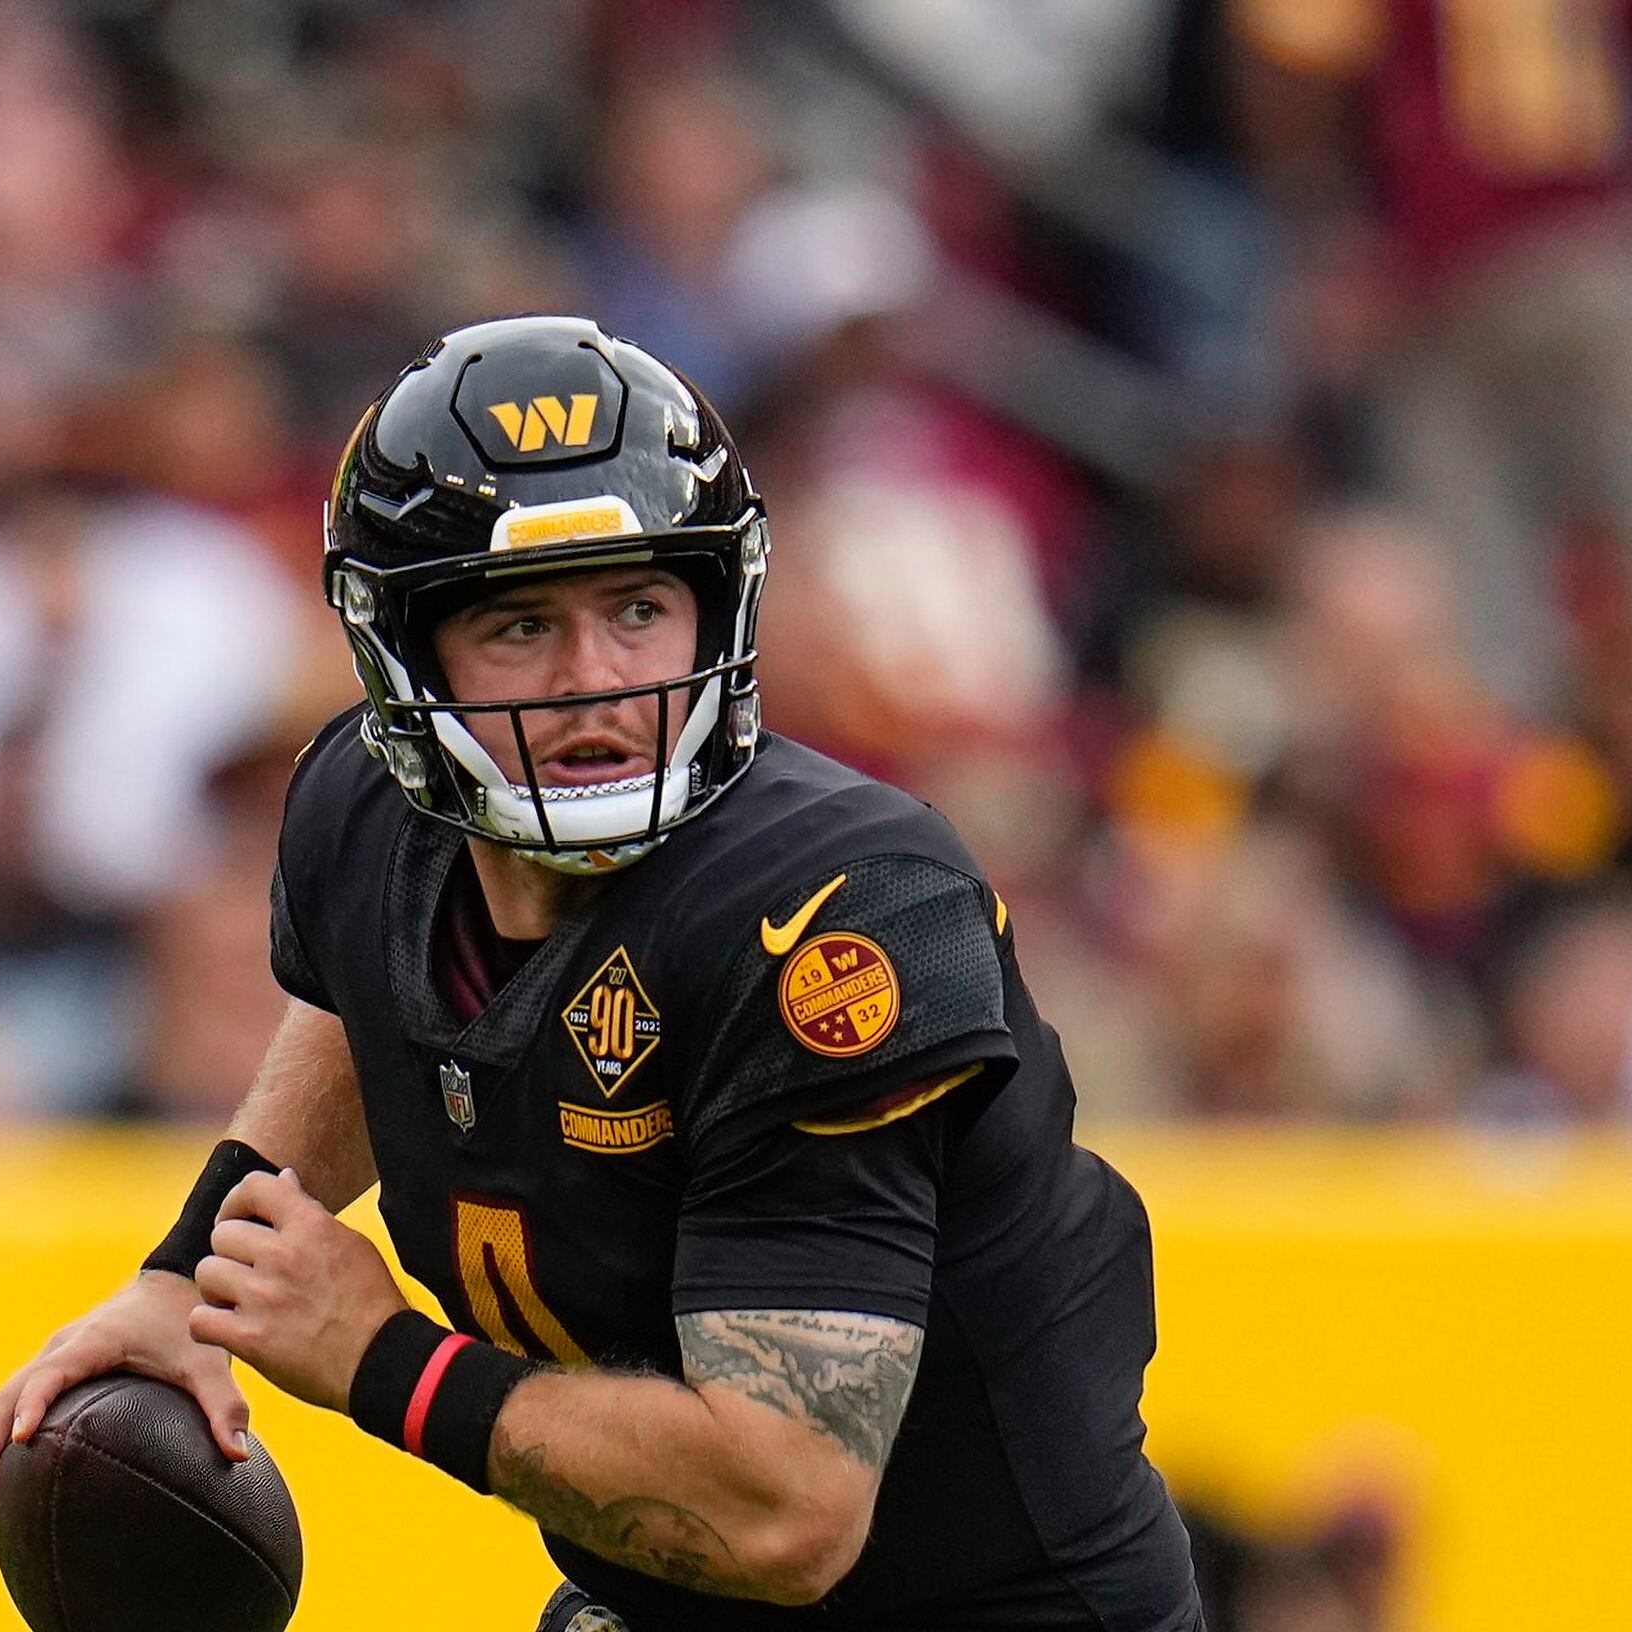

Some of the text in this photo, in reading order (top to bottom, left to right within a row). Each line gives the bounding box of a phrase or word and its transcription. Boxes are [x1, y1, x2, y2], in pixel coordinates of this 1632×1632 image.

[488, 394, 598, 452] W
[792, 967, 887, 1021] COMMANDERS
[800, 969, 822, 988] 19
[588, 985, 635, 1059] 90
[857, 1003, 881, 1023] 32
